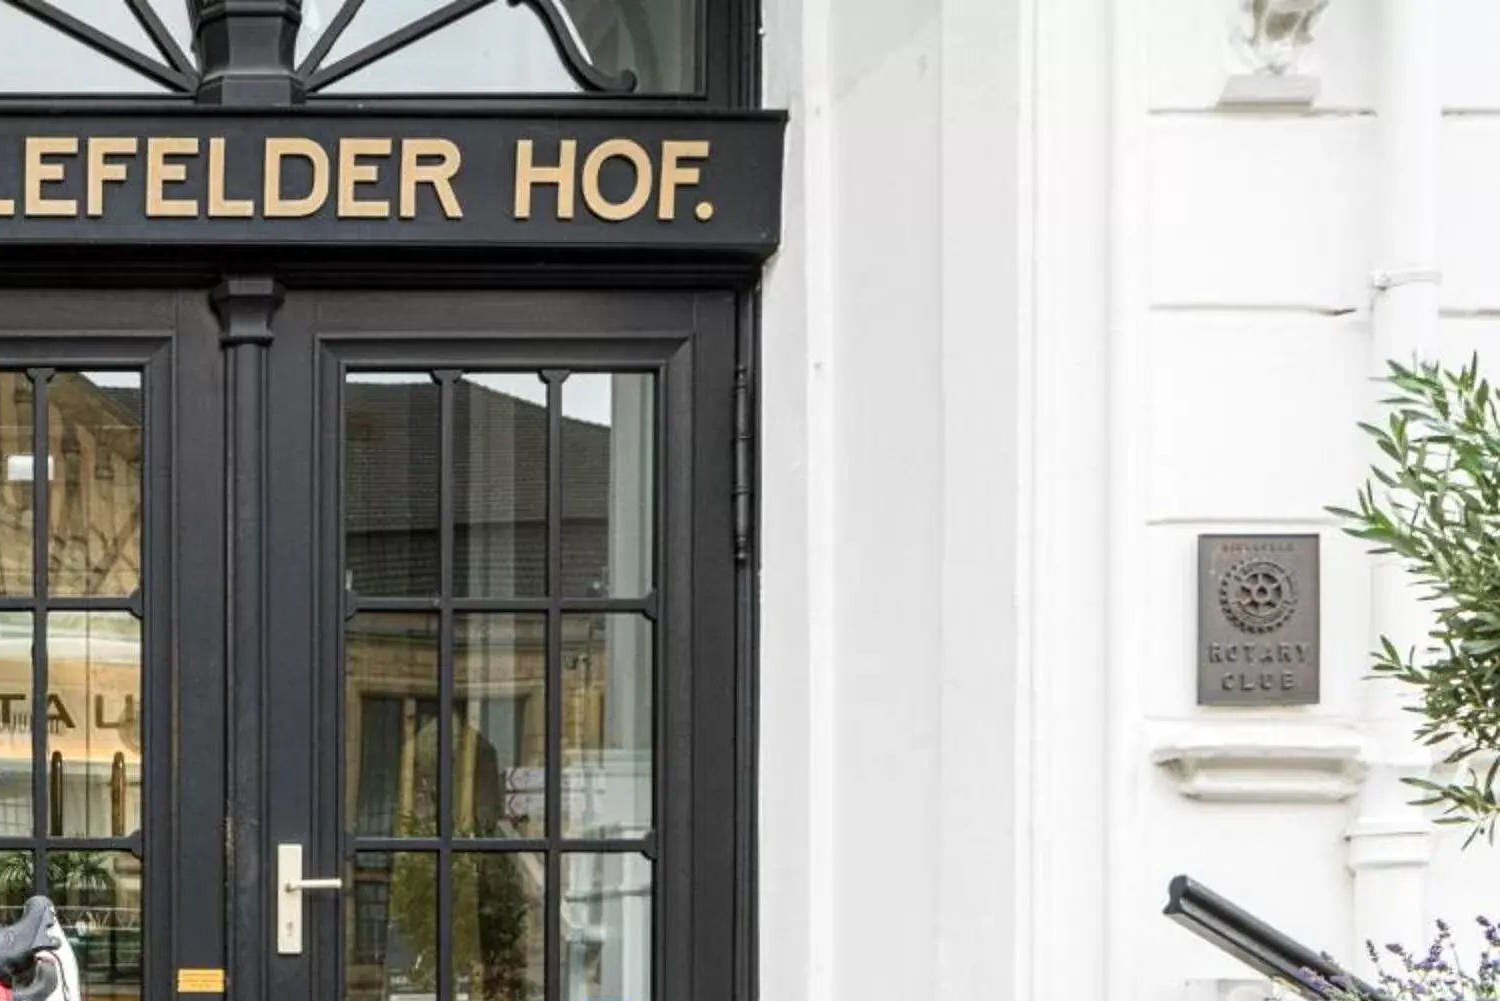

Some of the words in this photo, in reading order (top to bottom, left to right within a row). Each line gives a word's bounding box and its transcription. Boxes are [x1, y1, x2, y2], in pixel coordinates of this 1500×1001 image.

[514, 138, 714, 220] HOF.
[1208, 642, 1310, 664] ROTARY
[1221, 670, 1295, 692] CLUB
